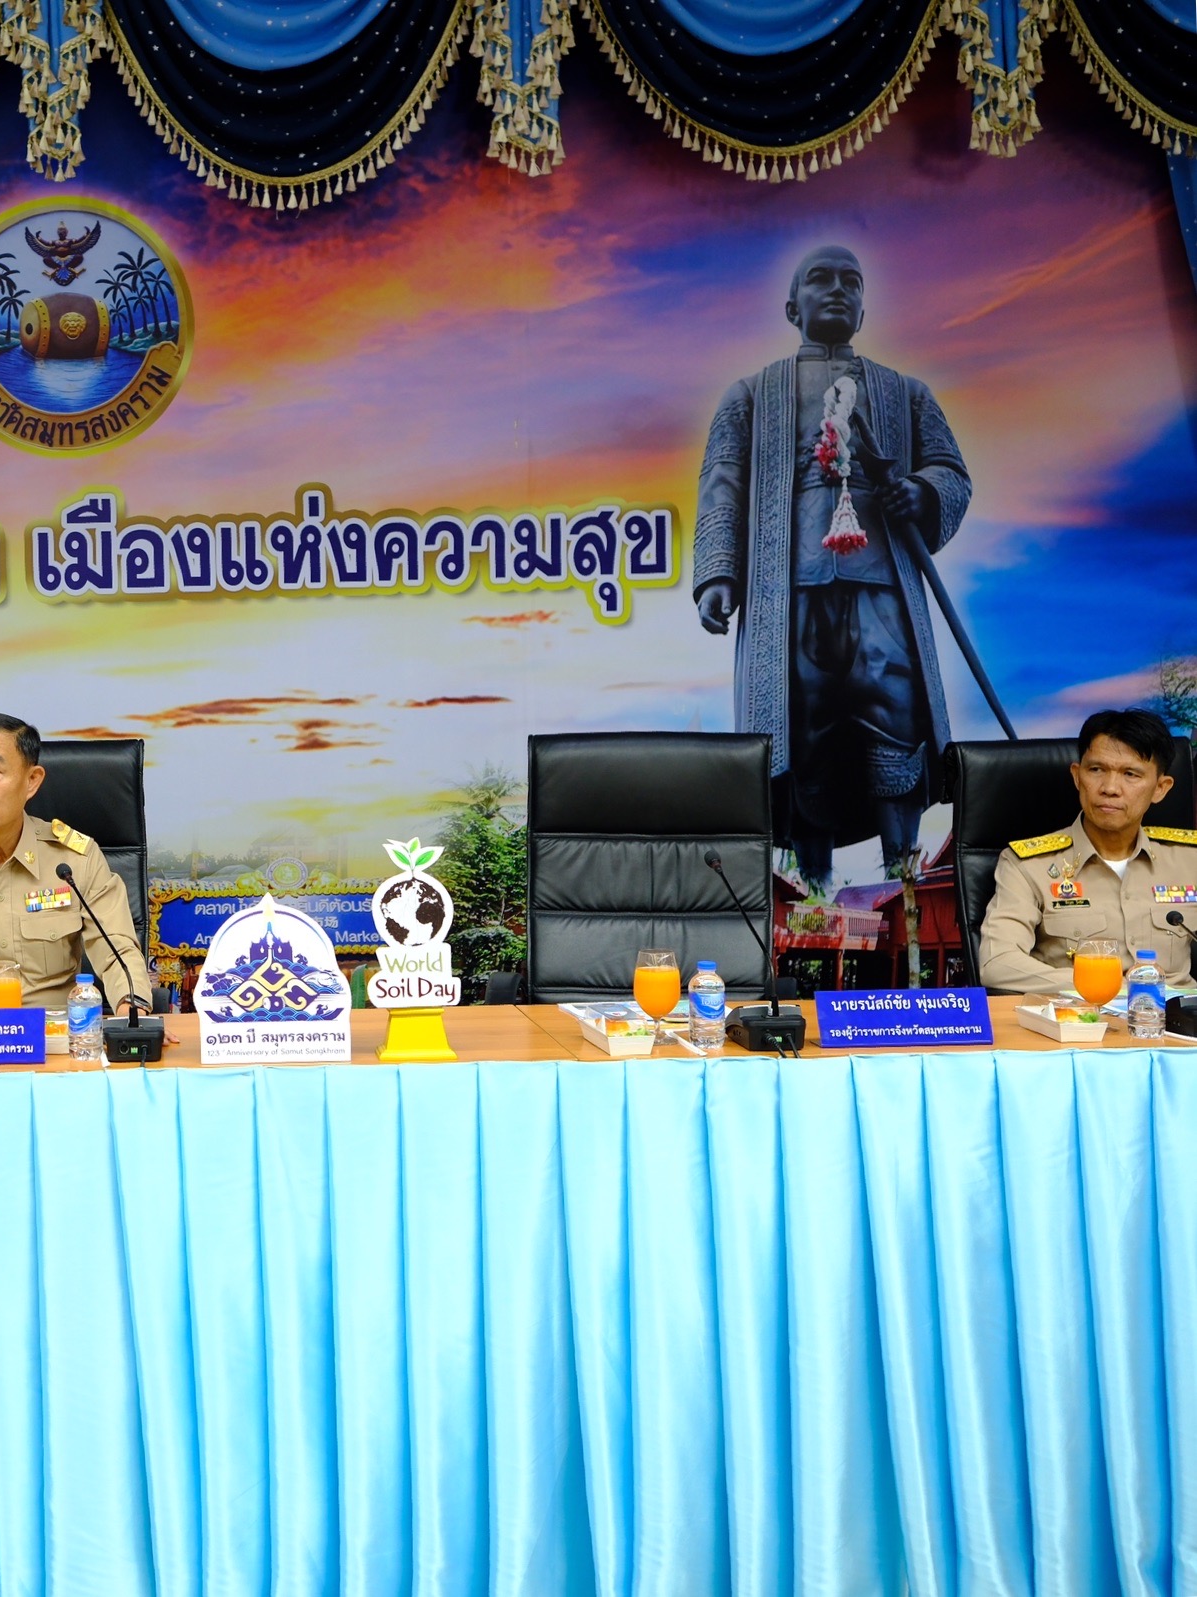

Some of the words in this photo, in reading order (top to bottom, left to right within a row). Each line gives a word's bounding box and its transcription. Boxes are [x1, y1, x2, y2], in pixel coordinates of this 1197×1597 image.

[37, 496, 668, 613] เมืองแห่งความสุข
[335, 930, 385, 944] Marke
[384, 951, 443, 973] World
[375, 978, 413, 998] Soil
[418, 977, 456, 1003] Day
